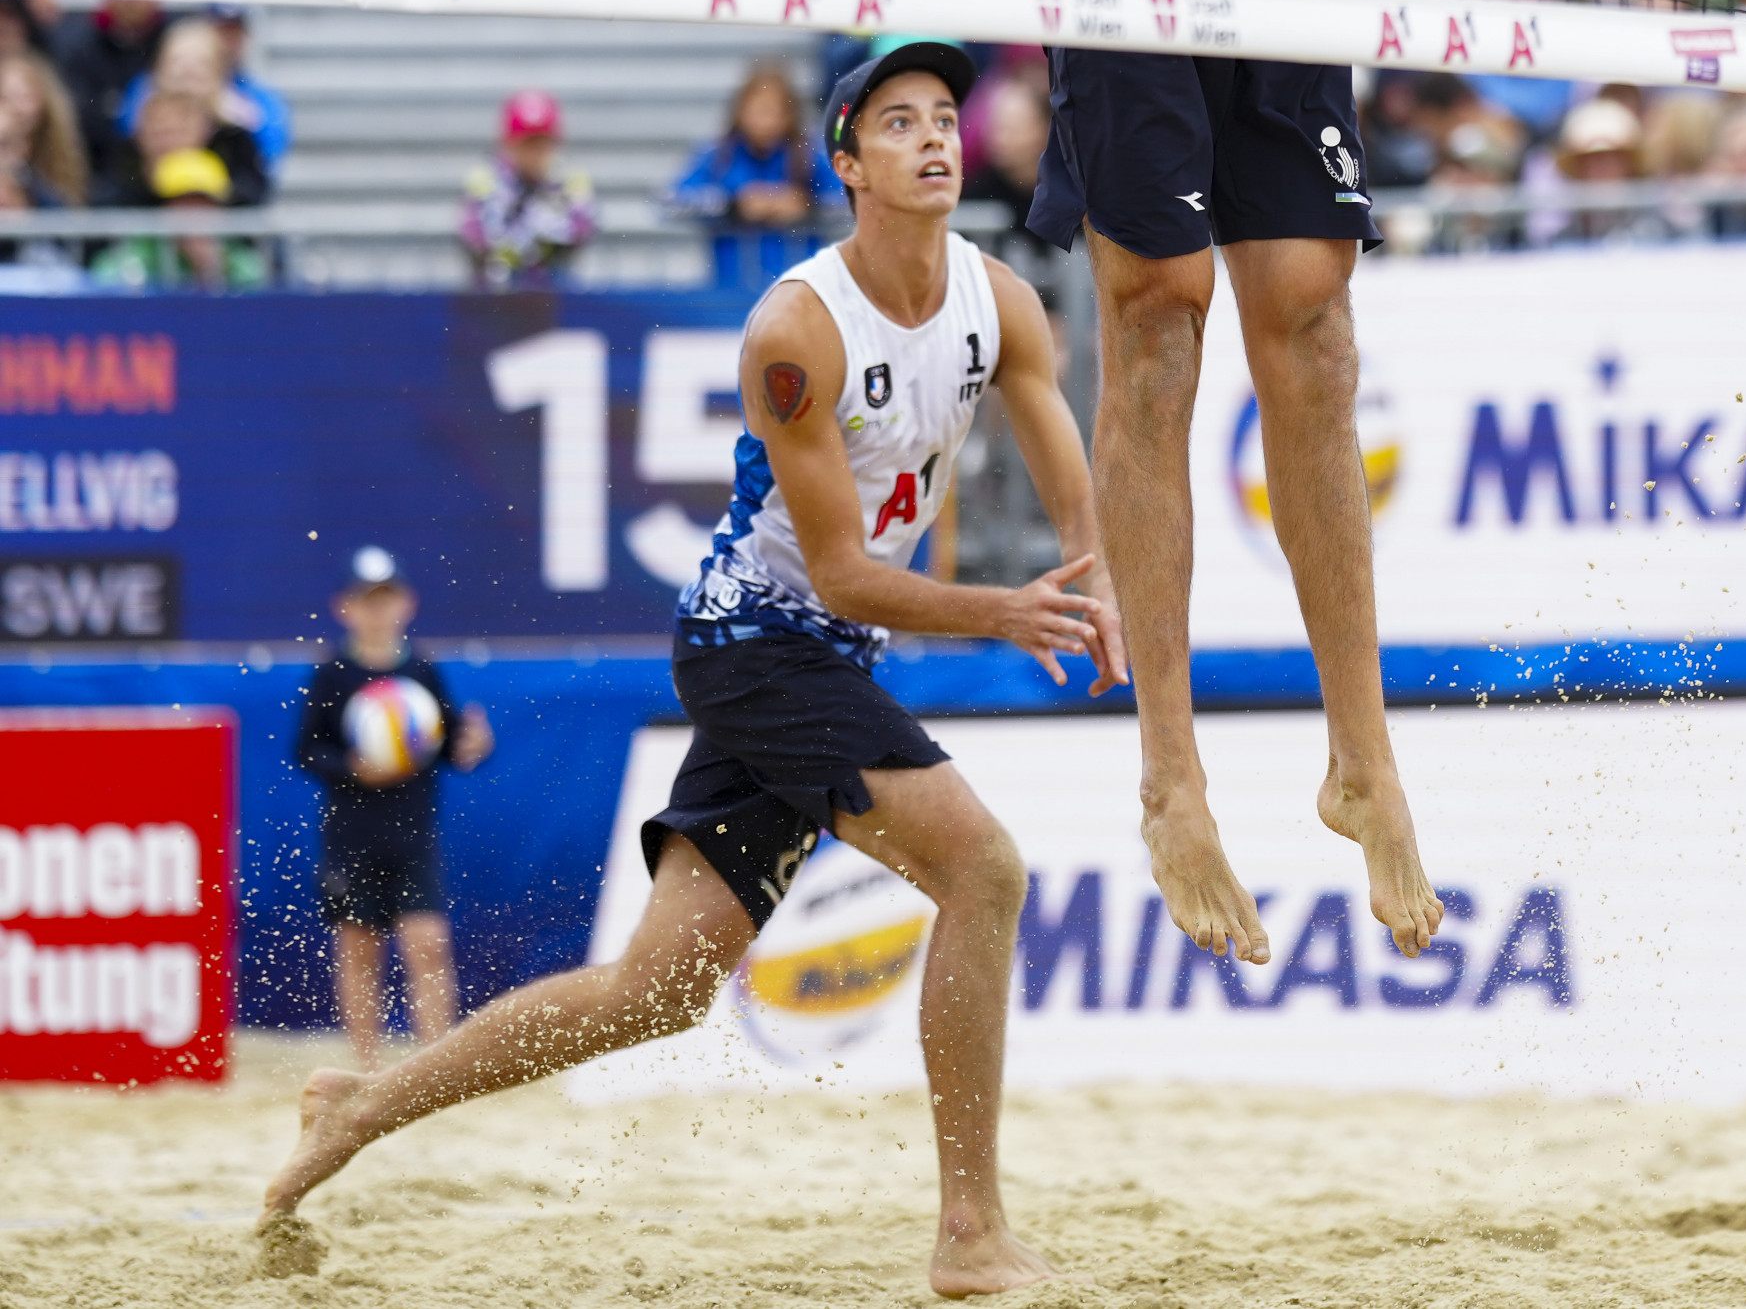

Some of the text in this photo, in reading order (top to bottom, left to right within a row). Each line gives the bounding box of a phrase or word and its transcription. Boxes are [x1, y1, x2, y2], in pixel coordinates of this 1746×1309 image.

[967, 333, 985, 375] 1
[872, 453, 940, 541] A1
[2, 564, 165, 635] SWE
